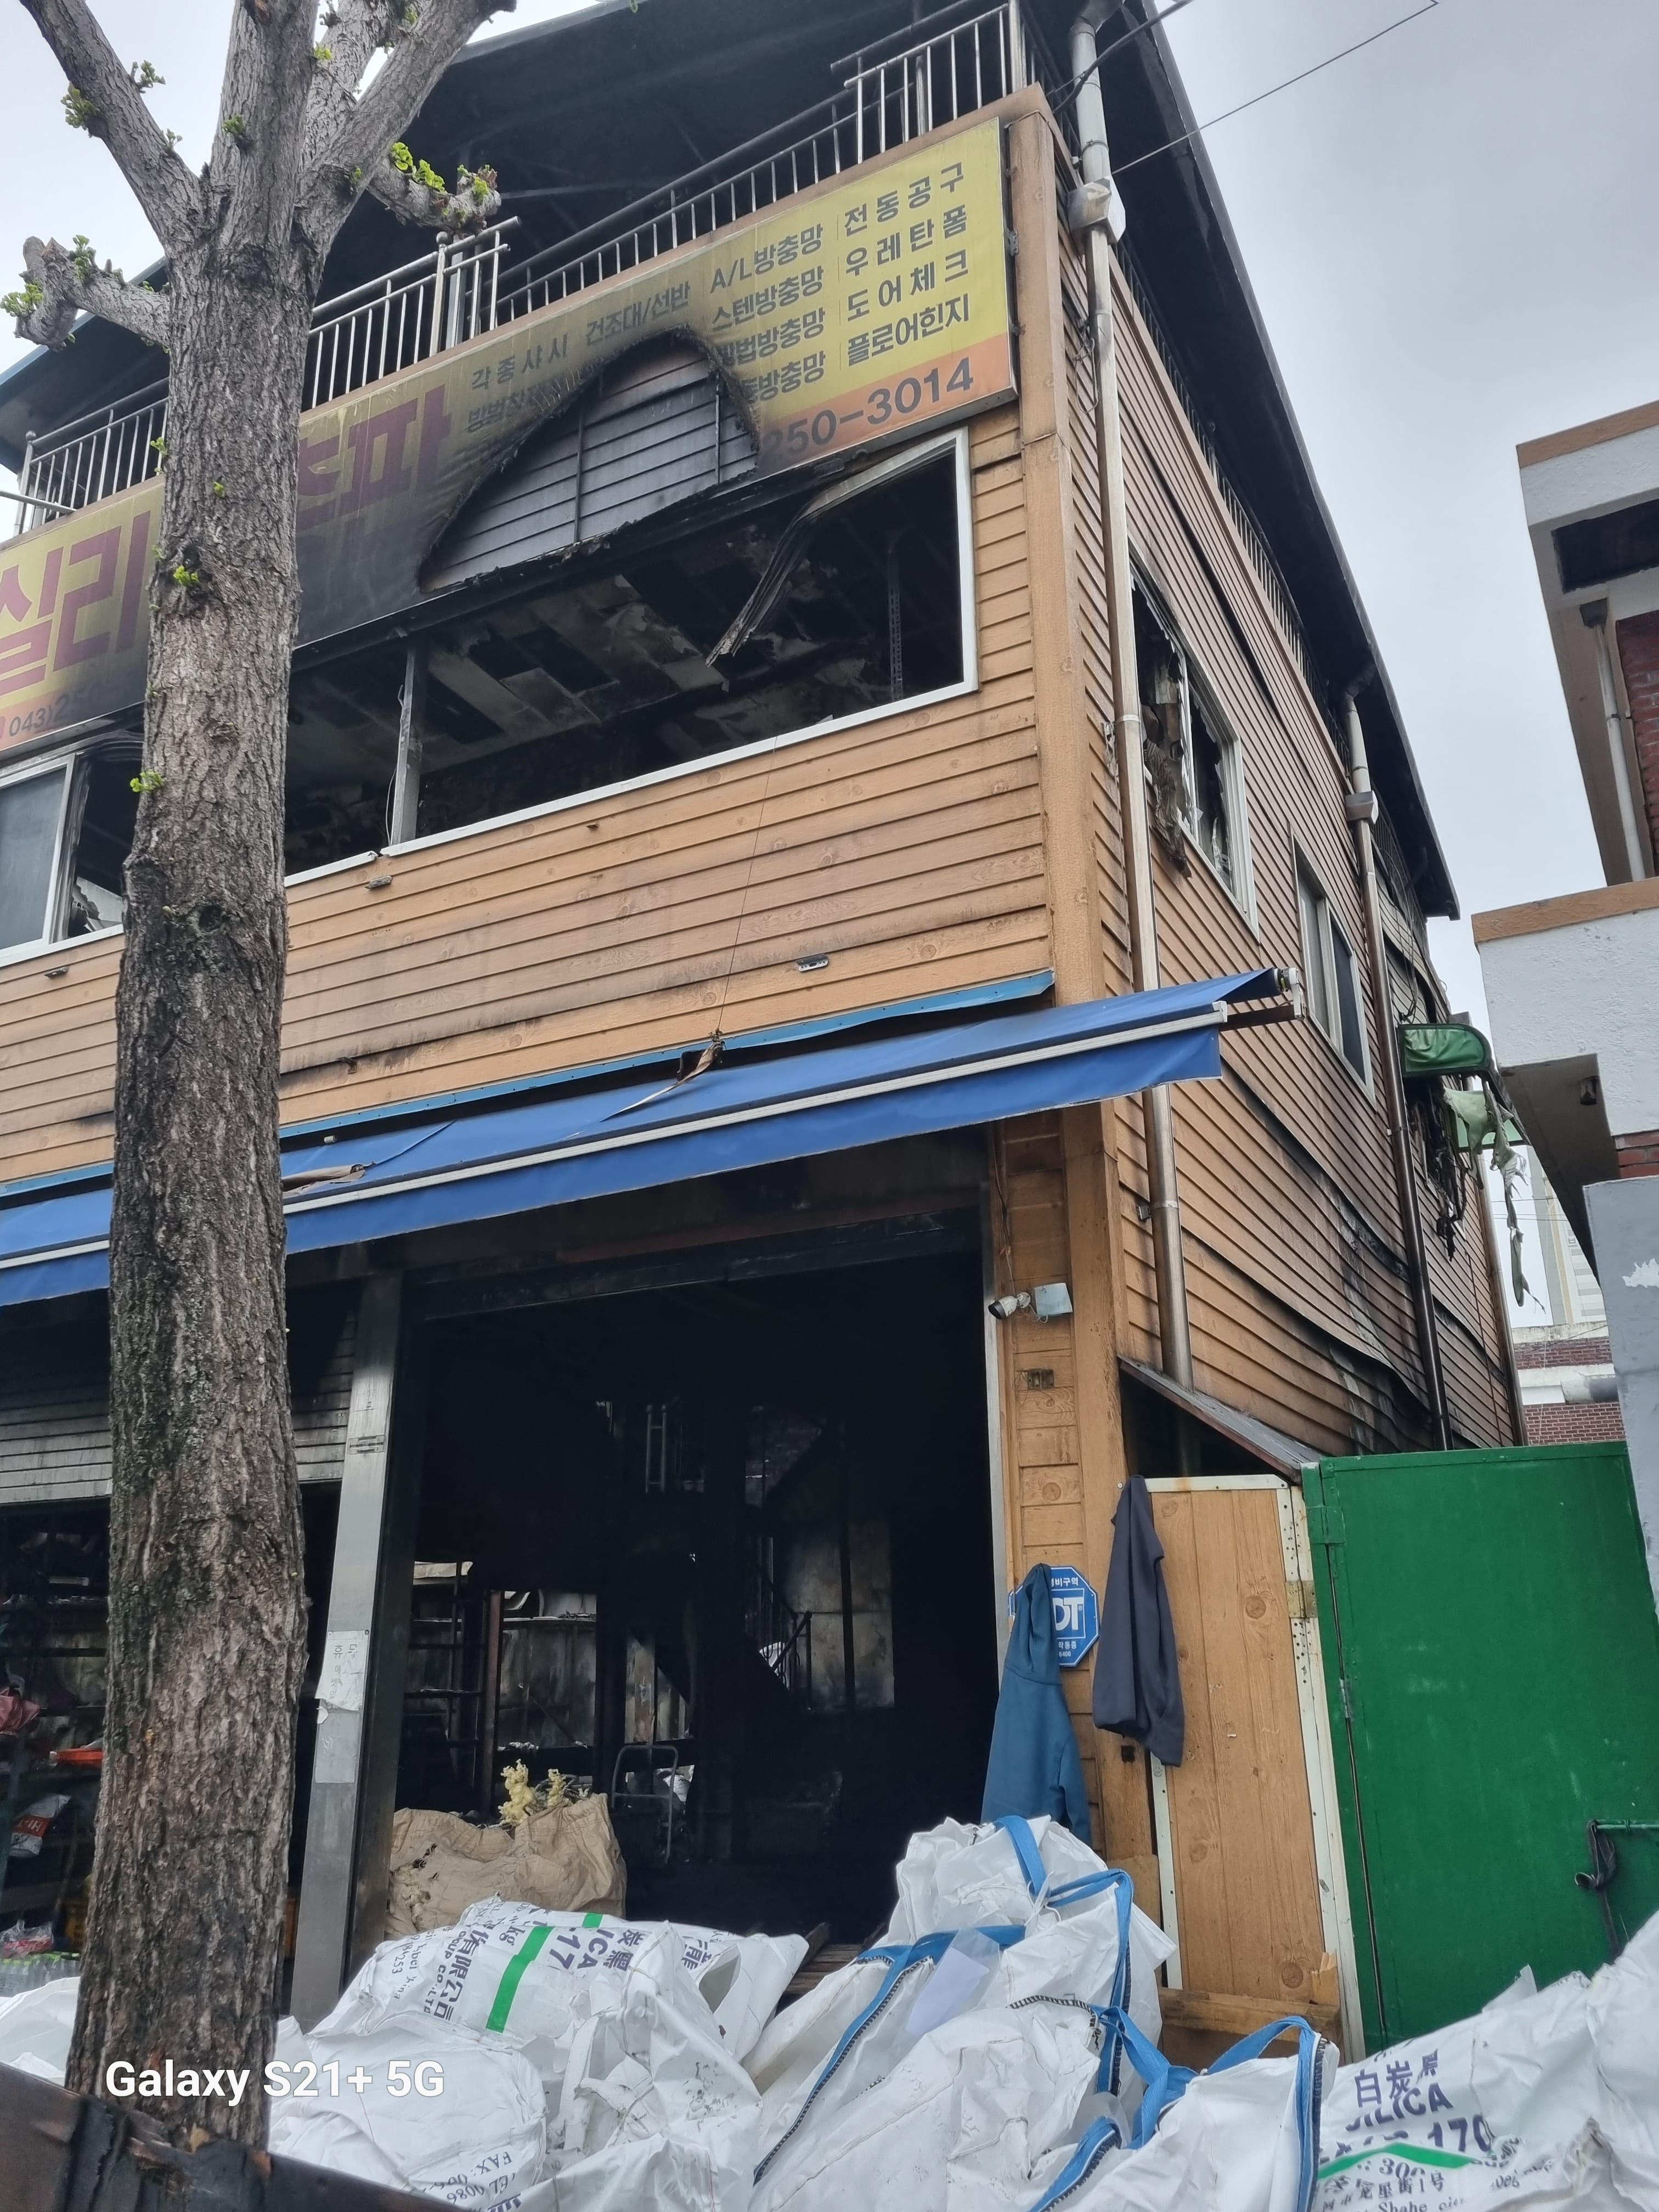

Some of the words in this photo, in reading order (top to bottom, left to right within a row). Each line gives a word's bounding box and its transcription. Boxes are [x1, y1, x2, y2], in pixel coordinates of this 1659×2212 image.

[844, 162, 964, 237] 전동공구
[710, 223, 825, 295] A/L방충망
[845, 204, 968, 276] 우레탄폼
[586, 280, 691, 346] 건조대/선반
[713, 265, 825, 330] 스텐방충망
[847, 249, 969, 323] 도어체크
[847, 294, 970, 367] 플로어힌지
[1052, 1597, 1085, 1631] DT
[488, 2172, 517, 2195] EL
